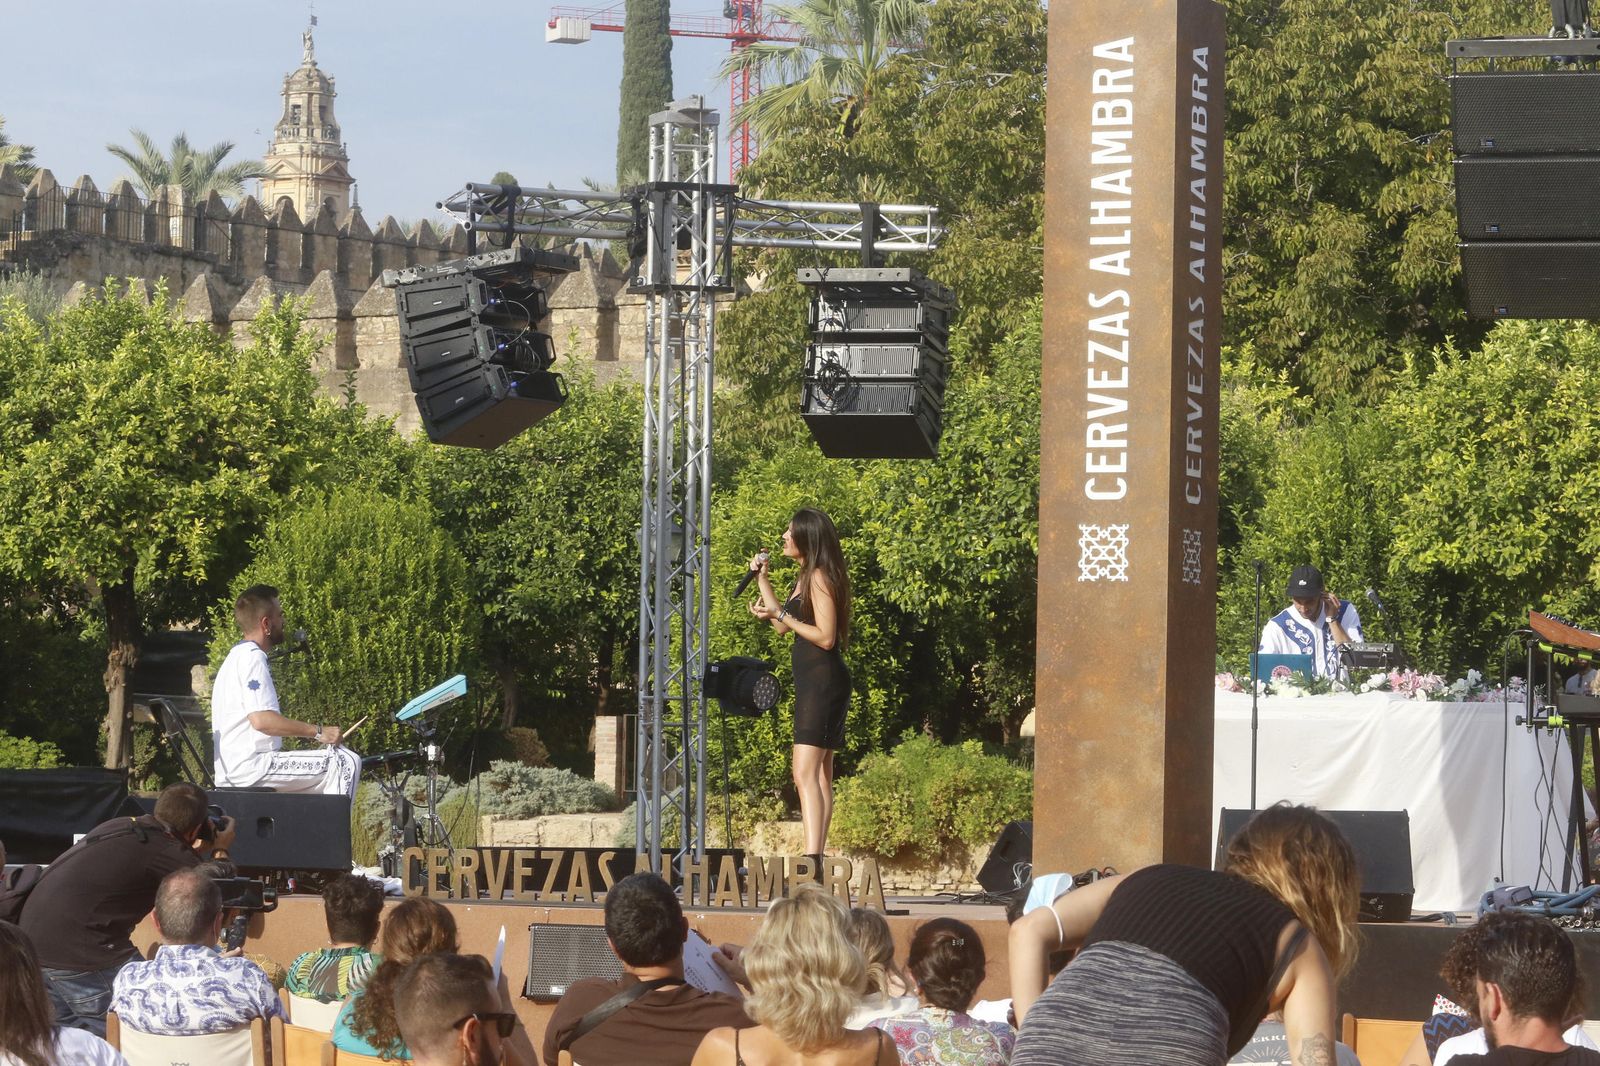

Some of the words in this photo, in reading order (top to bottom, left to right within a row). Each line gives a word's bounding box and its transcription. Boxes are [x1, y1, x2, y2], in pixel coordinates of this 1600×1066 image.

[1089, 36, 1134, 276] ALHAMBRA
[1189, 46, 1209, 283] ALHAMBRA
[1084, 289, 1130, 500] CERVEZAS
[1185, 296, 1205, 505] CERVEZAS
[402, 846, 617, 904] CERVEZAS
